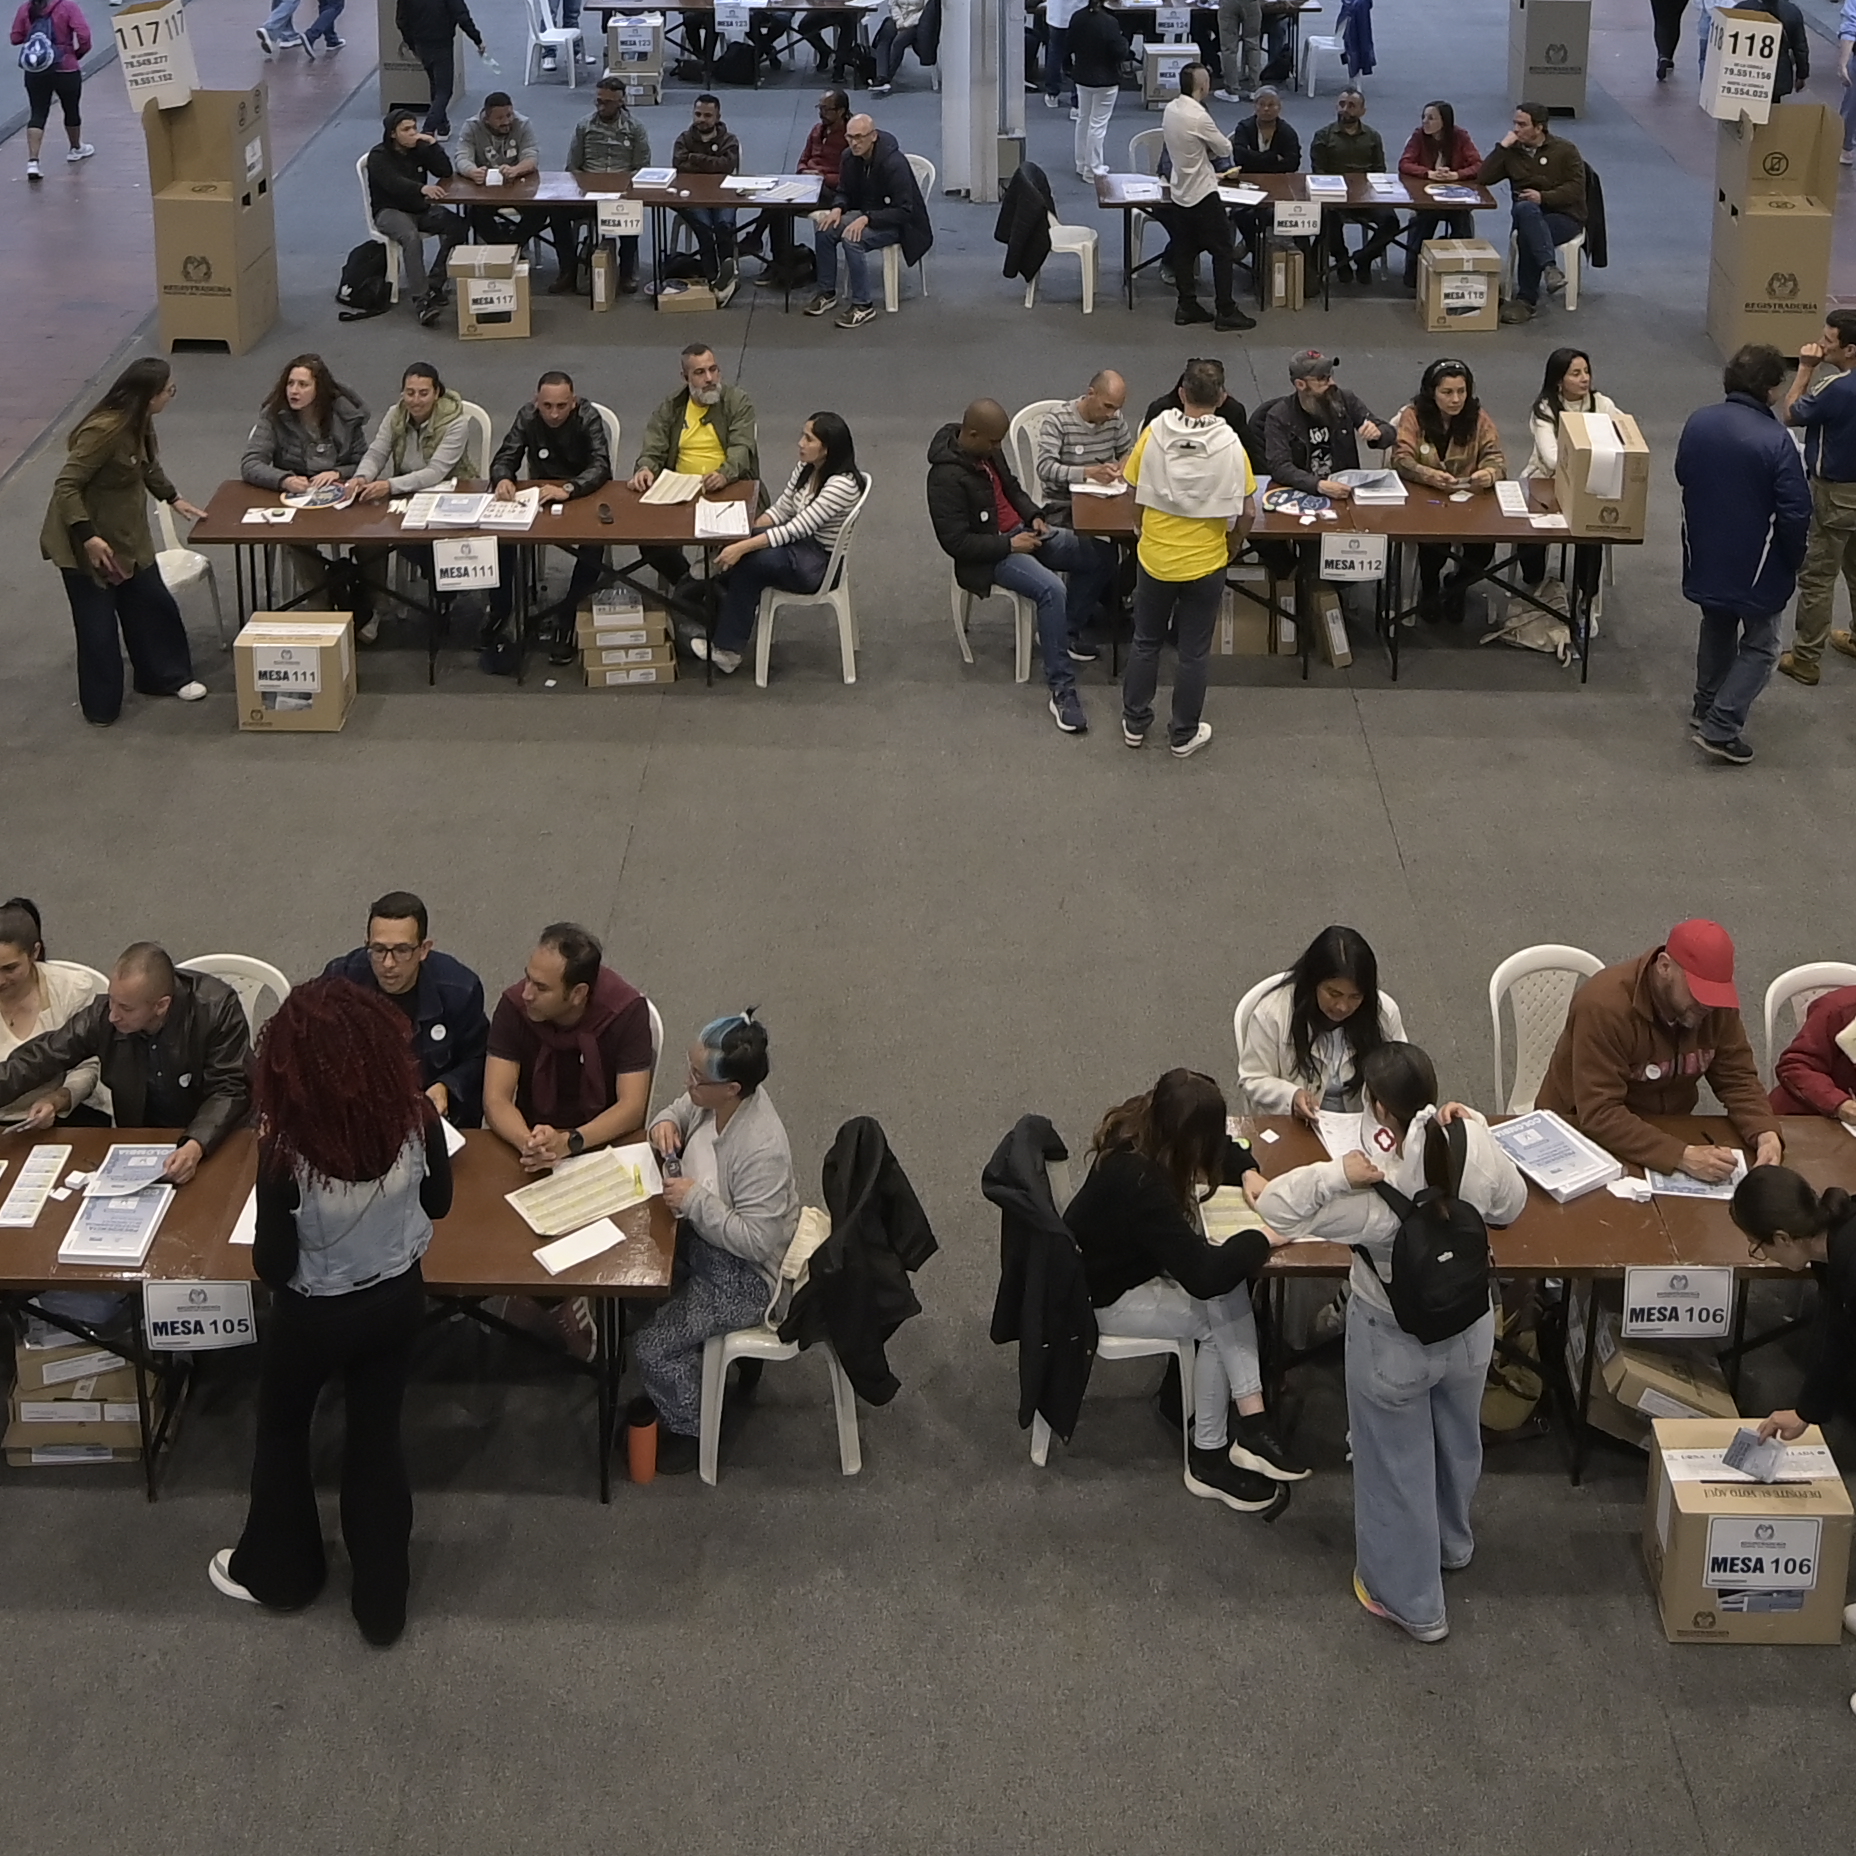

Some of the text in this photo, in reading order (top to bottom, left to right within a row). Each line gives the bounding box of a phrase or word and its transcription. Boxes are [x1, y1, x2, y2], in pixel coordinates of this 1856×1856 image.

[165, 9, 185, 41] 117
[115, 20, 160, 51] 117
[1711, 22, 1724, 52] 118
[1728, 30, 1775, 60] 118
[600, 218, 641, 228] MESA 117
[1277, 219, 1299, 229] MESA
[472, 294, 513, 305] MESA 117
[1443, 291, 1465, 301] MESA
[439, 564, 494, 580] MESA 111
[1324, 558, 1383, 571] MESA 112
[257, 669, 316, 683] MESA 111
[1629, 1306, 1725, 1324] MESA 106
[152, 1317, 250, 1336] MESA 105
[1710, 1556, 1813, 1575] MESA 106
